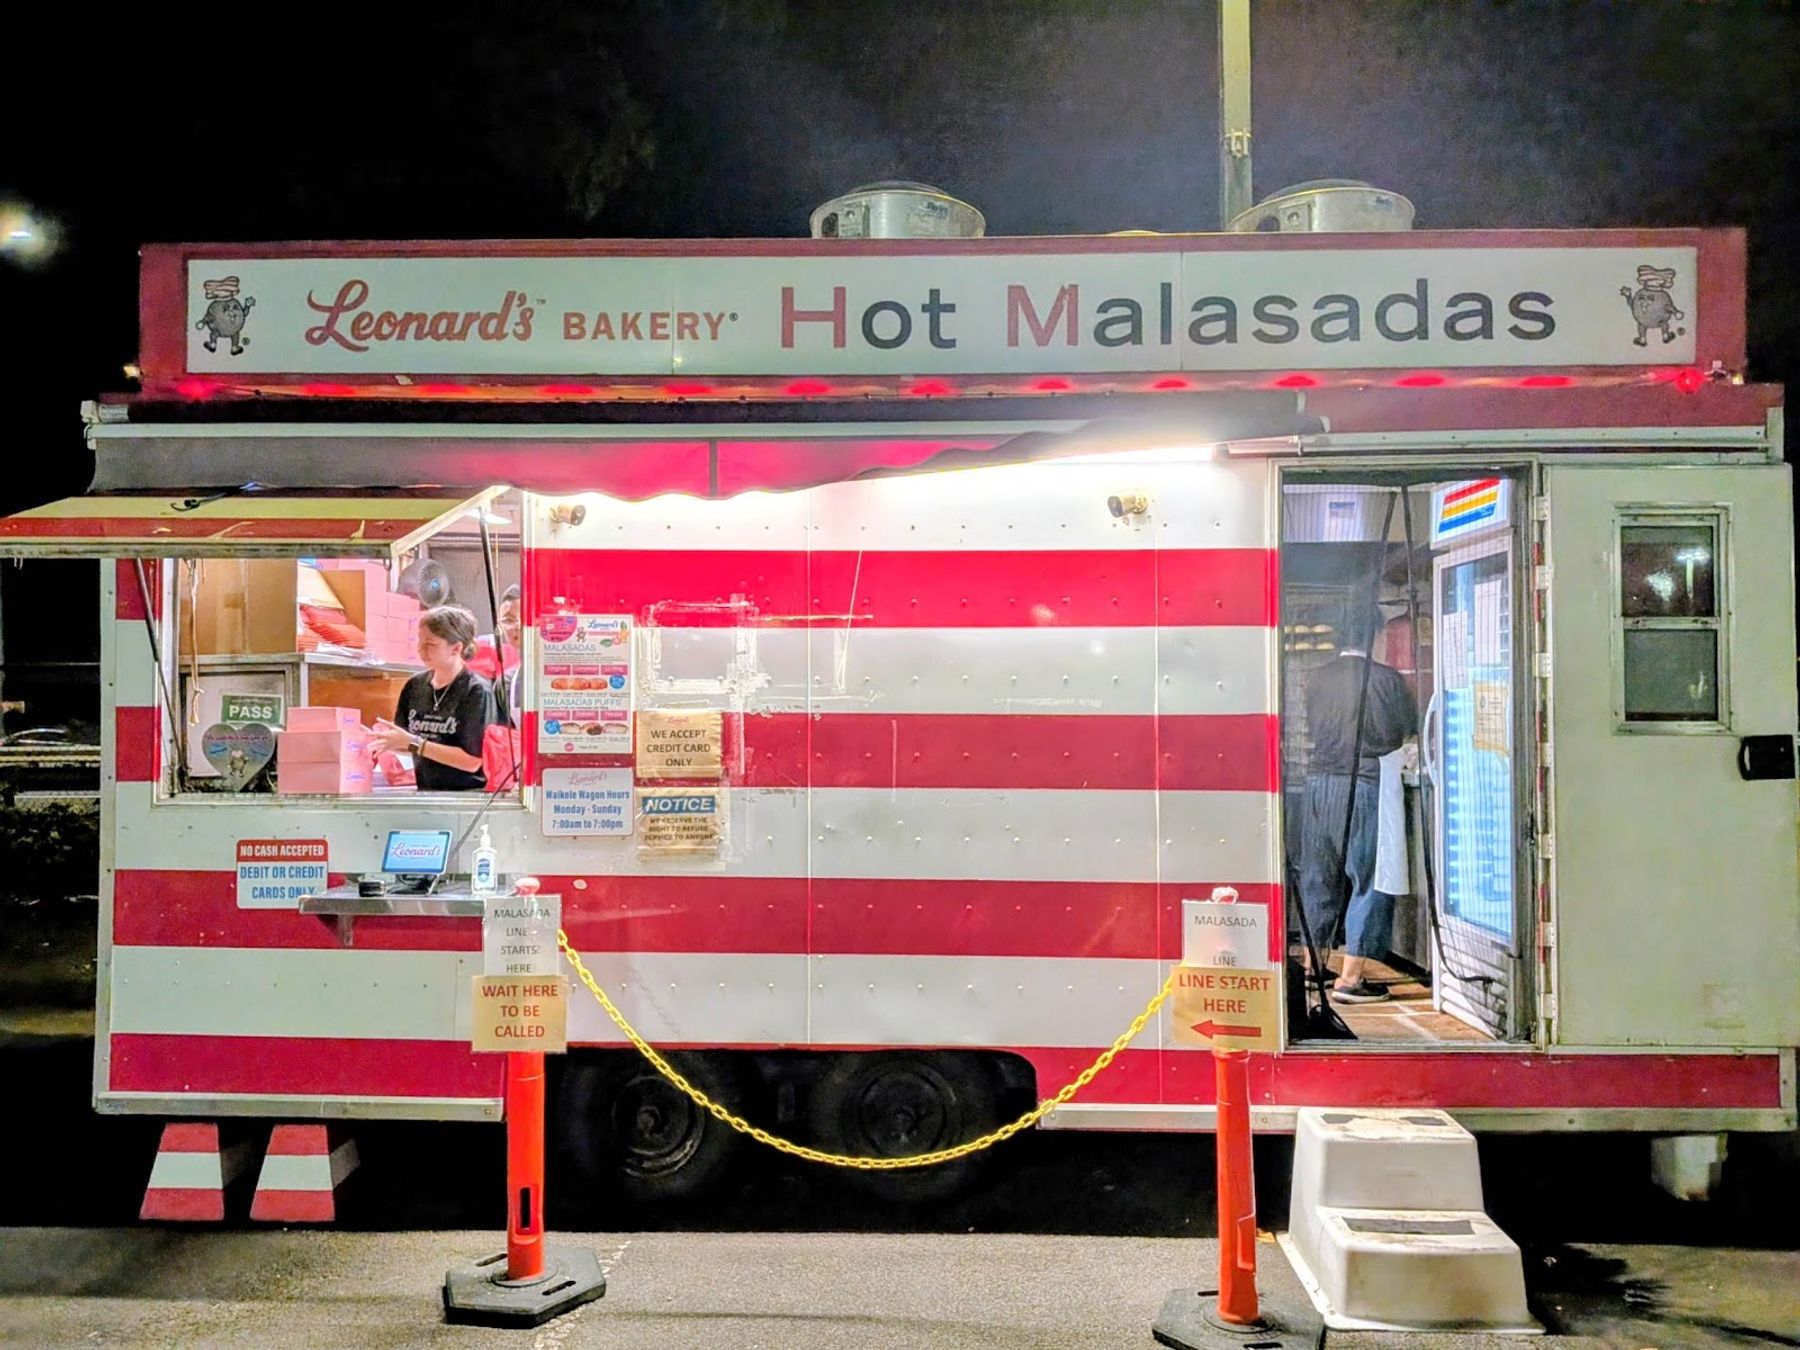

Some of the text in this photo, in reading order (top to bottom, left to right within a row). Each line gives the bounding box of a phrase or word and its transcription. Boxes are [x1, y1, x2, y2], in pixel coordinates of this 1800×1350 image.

[305, 279, 535, 352] Leonard's
[564, 311, 726, 341] BAKERY
[779, 277, 1557, 350] Hot Malasadas
[229, 704, 272, 719] PASS
[651, 729, 707, 738] WE ACCEPT
[647, 744, 711, 753] CREDIT CARD
[665, 758, 693, 767] ONLY
[546, 790, 630, 801] Waikele Wagon Hours
[553, 804, 586, 815] Monday
[592, 804, 622, 815] Sunday
[646, 798, 713, 811] NOTICE
[552, 819, 623, 830] 7:00am to 7:00pm
[240, 845, 324, 857] NO CASH ACCEPTED
[391, 841, 441, 859] Leonard's
[240, 866, 325, 879] DEBIT OR CREDIT
[252, 886, 315, 899] CARDS ONLY
[1194, 915, 1257, 928] MALASADA
[506, 927, 528, 937] LINE
[500, 945, 537, 955] STARTS
[1213, 956, 1237, 966] LINE
[506, 964, 532, 973] HERE
[1179, 974, 1271, 991] LINE START
[482, 984, 558, 997] WAIT HERE
[500, 1005, 540, 1017] TO BE
[1203, 998, 1246, 1013] HERE
[494, 1025, 545, 1038] CALLED
